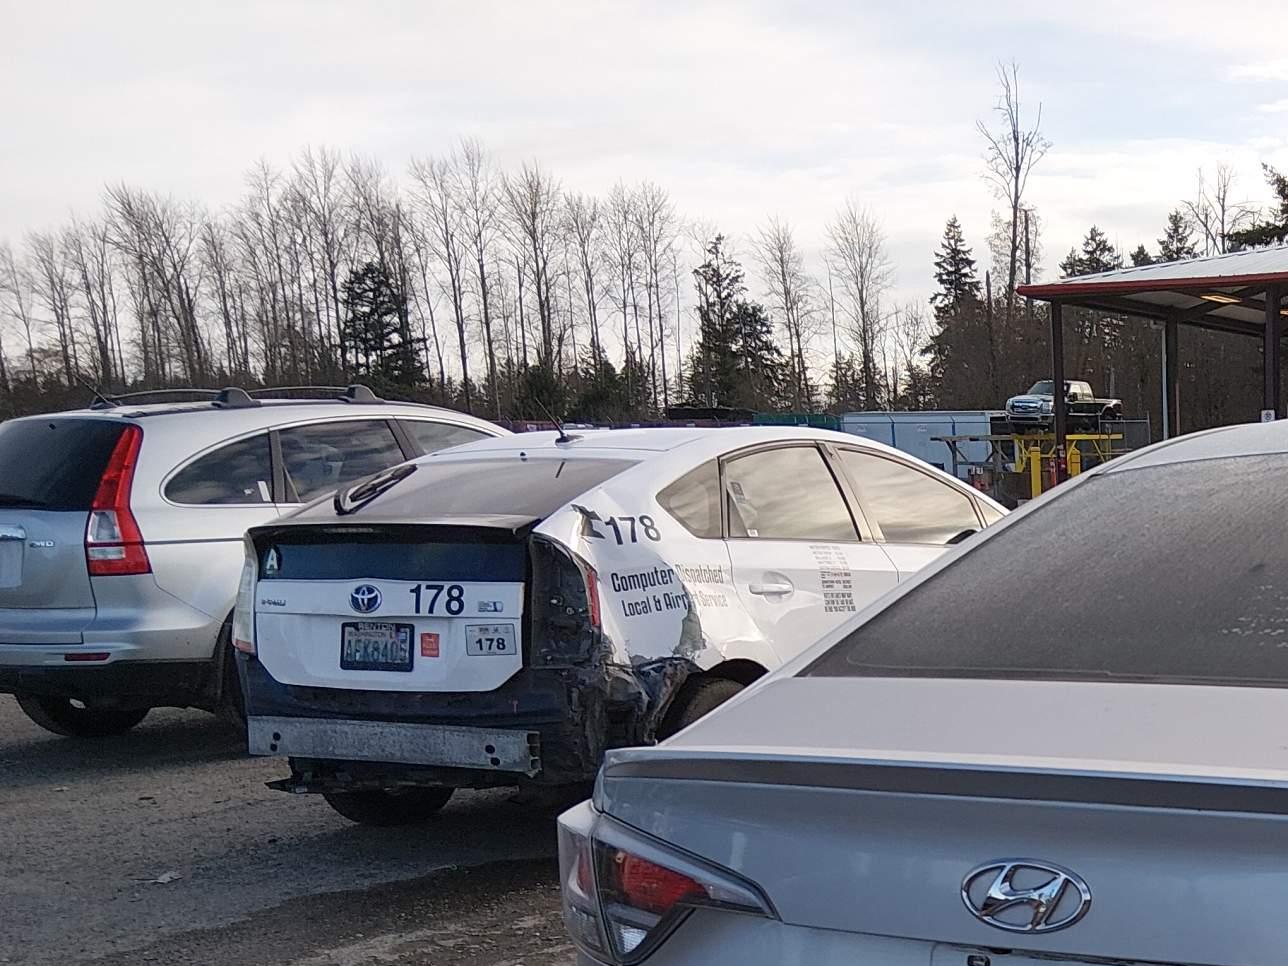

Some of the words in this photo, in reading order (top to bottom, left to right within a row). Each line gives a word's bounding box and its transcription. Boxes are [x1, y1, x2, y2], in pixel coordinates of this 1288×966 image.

[604, 514, 661, 546] 178
[610, 566, 675, 593] Computer
[674, 562, 724, 586] Dispatched
[409, 583, 465, 616] 178
[621, 595, 652, 617] Local
[651, 592, 663, 612] &
[474, 636, 506, 651] 178
